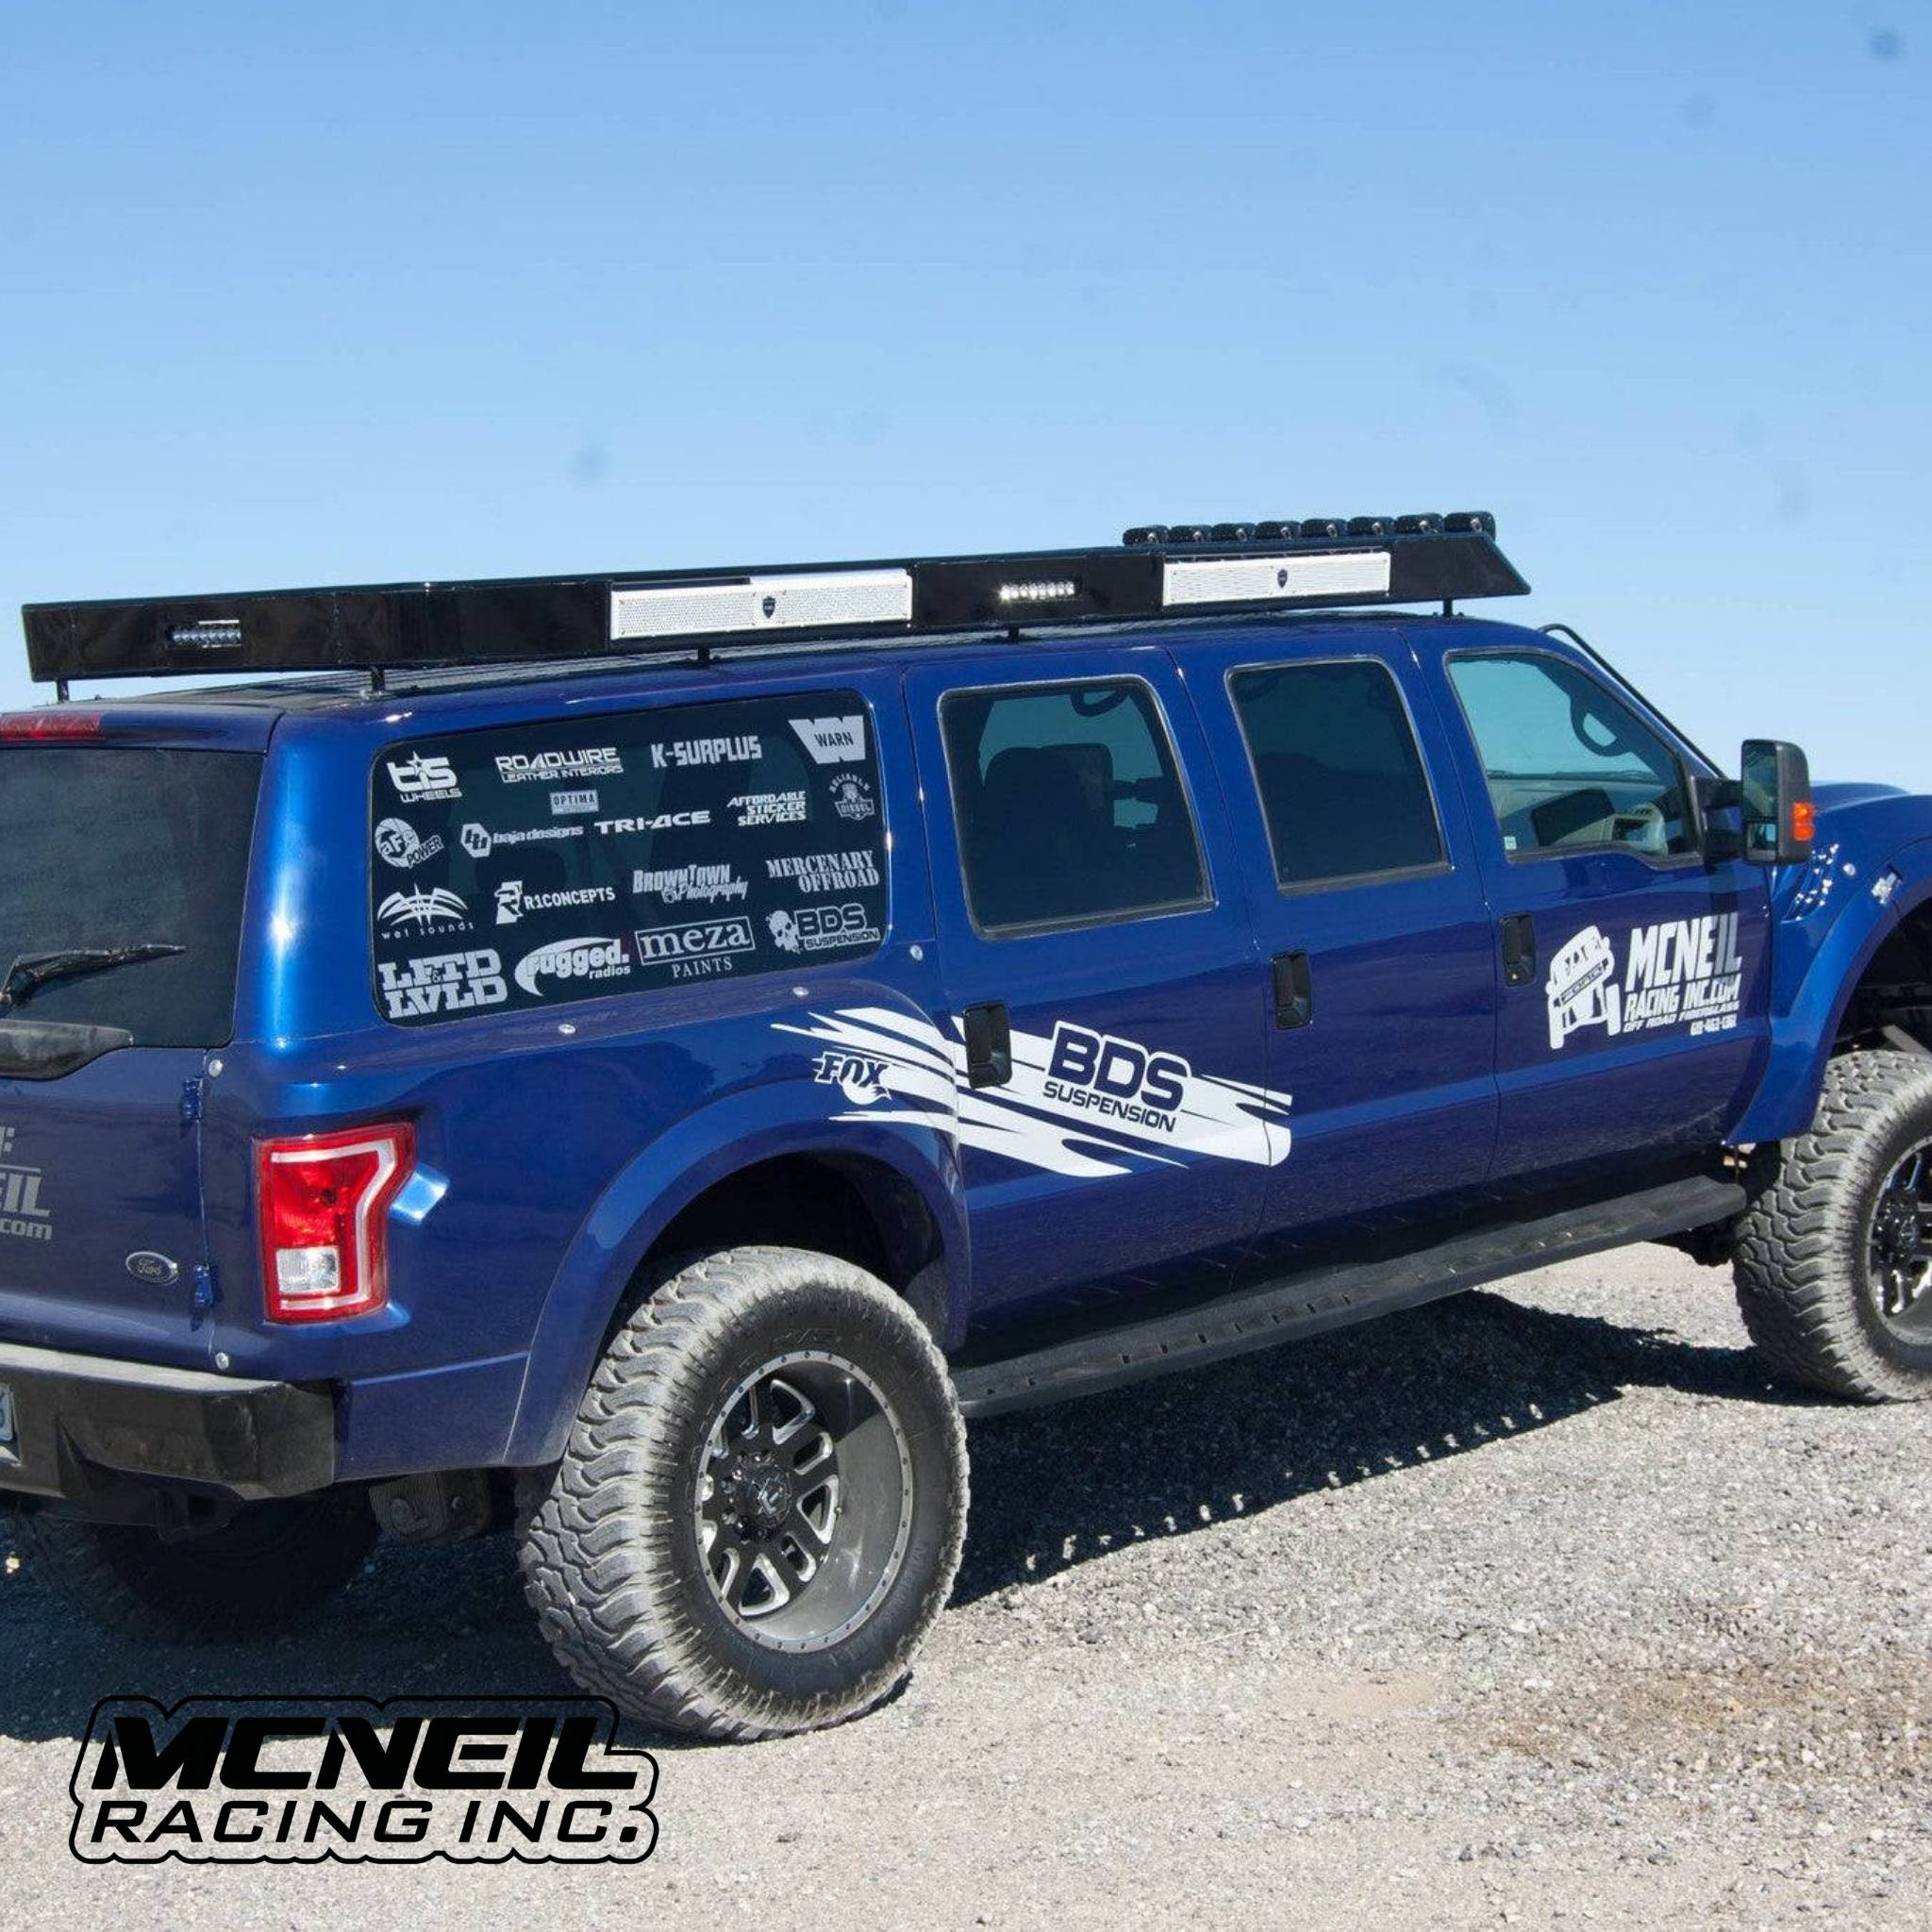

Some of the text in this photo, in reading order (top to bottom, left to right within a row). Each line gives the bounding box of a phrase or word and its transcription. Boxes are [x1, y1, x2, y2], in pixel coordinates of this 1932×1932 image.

[651, 735, 762, 768] K-SURPLUS
[814, 731, 854, 748] WARN
[494, 747, 621, 773] ROADWIRE
[501, 770, 559, 784] LEATHER
[400, 787, 463, 803] WHEELS
[552, 793, 596, 807] OPTIMA
[746, 801, 807, 815] STICKER
[594, 809, 711, 835] TRI-ACE
[737, 810, 807, 826] SERVICES
[493, 825, 584, 844] baja designs
[406, 835, 445, 867] POWER
[765, 850, 874, 878] MERCENARY
[798, 868, 880, 894] OFFROAD
[524, 887, 616, 910] R1CONCEPTS
[381, 922, 474, 941] wet sounds
[794, 904, 867, 939] BDS
[640, 923, 752, 959] meza
[806, 929, 880, 950] SUSPENSION
[1625, 912, 1742, 991] MCNEIL
[589, 965, 631, 980] radios
[672, 957, 733, 978] PAINTS
[384, 975, 508, 1019] LVLD
[1624, 985, 1680, 1023] RACING
[814, 1052, 891, 1090] FOX
[1048, 1023, 1189, 1111] BDS
[1042, 1080, 1176, 1133] SUSPENSION
